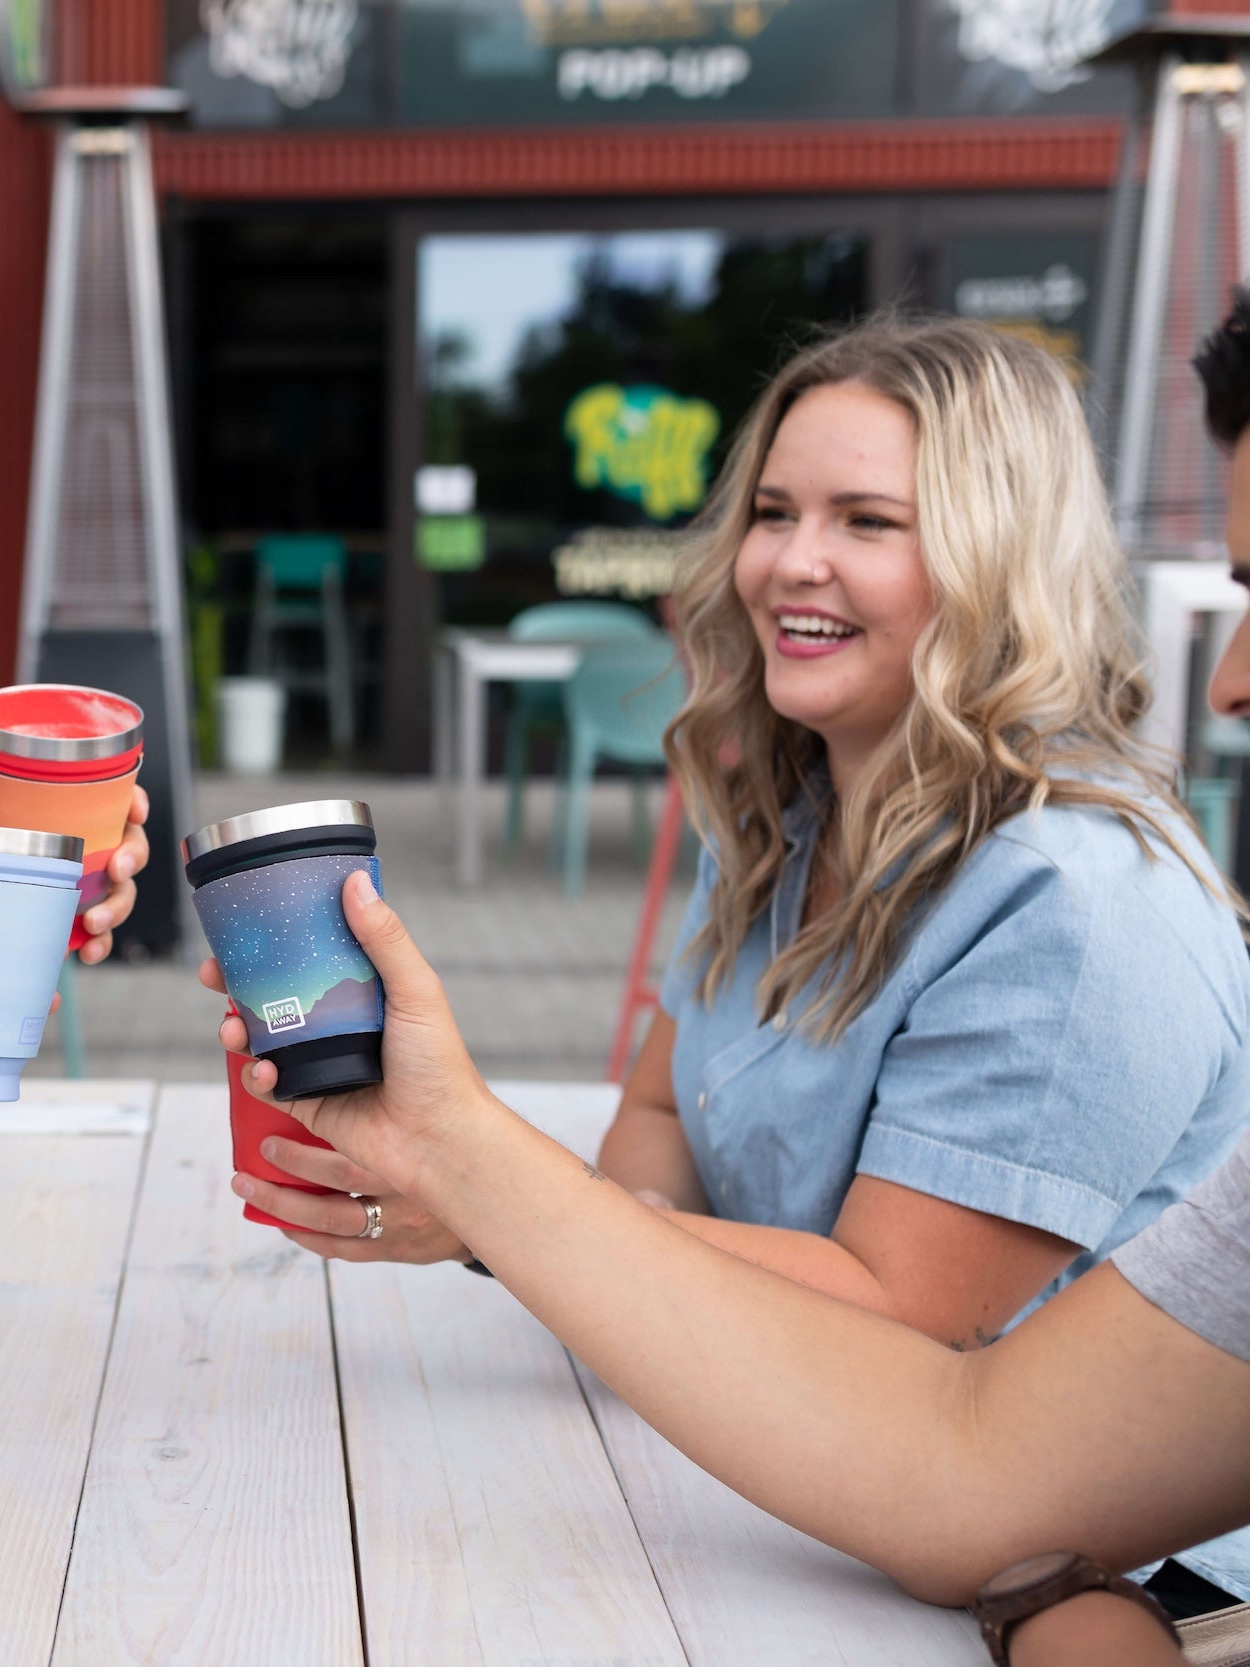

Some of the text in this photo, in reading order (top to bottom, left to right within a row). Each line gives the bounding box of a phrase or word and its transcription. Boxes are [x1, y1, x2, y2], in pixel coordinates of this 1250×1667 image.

[558, 47, 750, 99] POP-UP
[268, 1004, 295, 1018] HYD
[273, 1014, 296, 1027] AWAY
